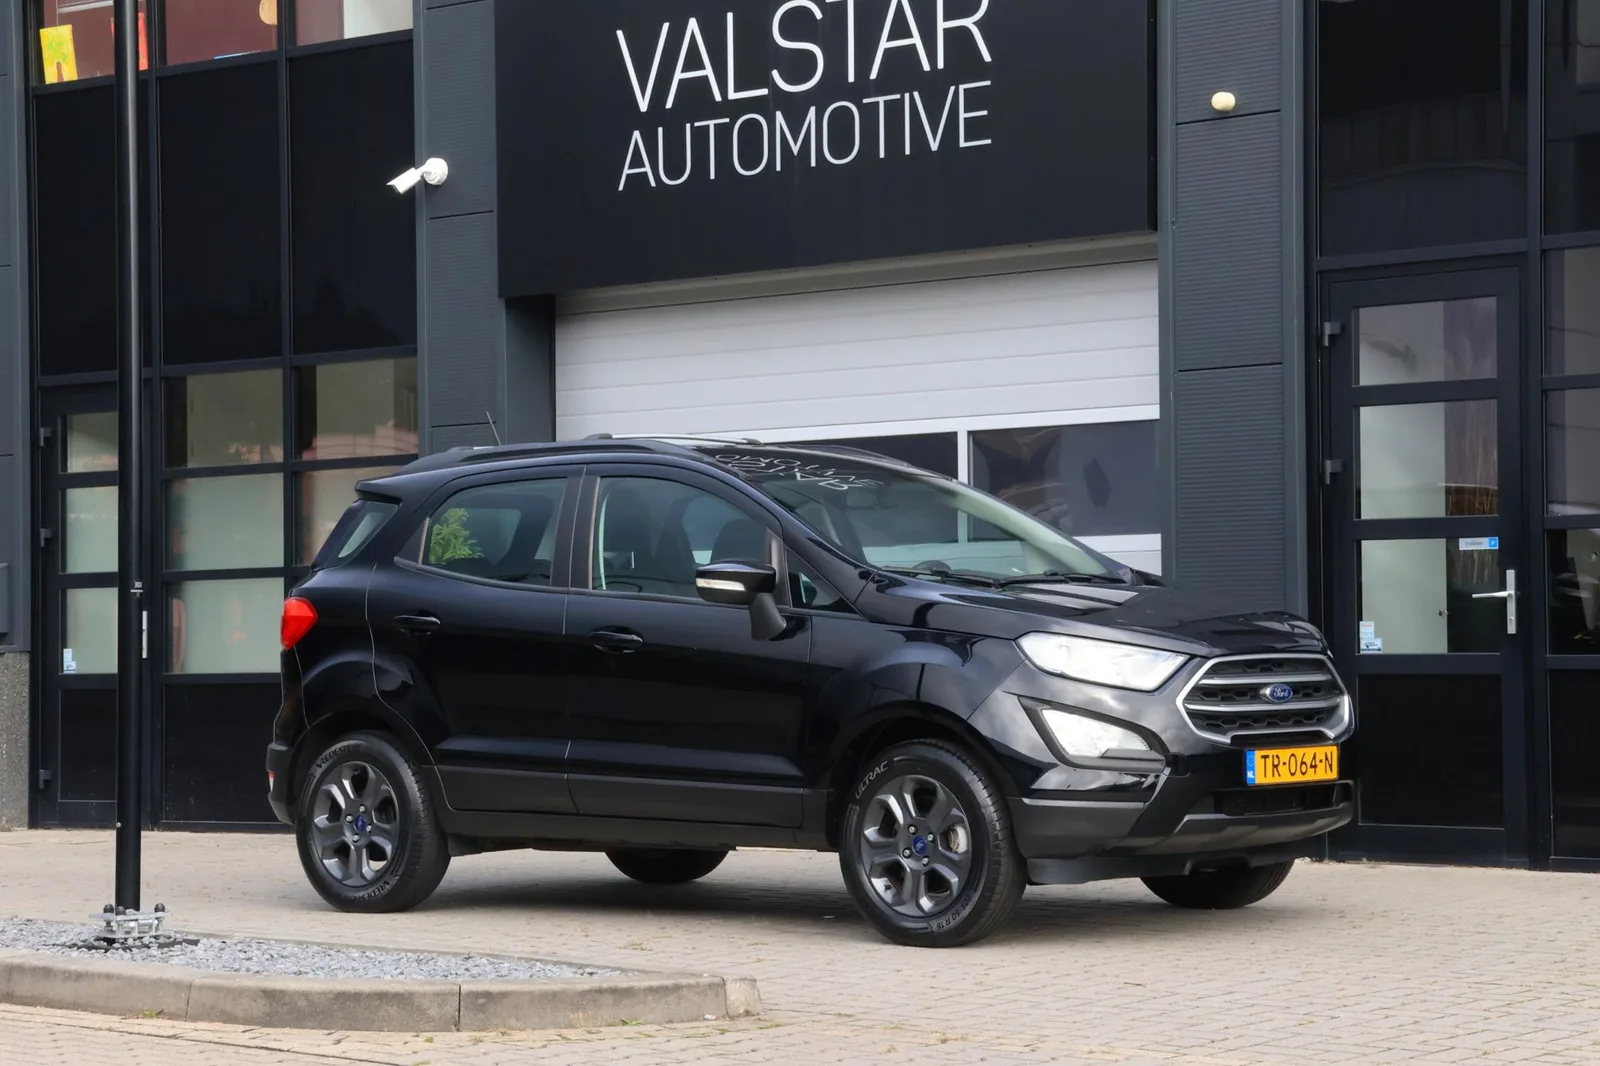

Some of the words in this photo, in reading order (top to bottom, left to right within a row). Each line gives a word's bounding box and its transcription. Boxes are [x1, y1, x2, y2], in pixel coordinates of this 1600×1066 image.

[616, 0, 992, 113] VALSTAR
[618, 80, 992, 191] AUTOMOTIVE
[1272, 686, 1291, 699] Ford
[854, 760, 889, 800] ULTRAC
[1247, 771, 1255, 779] NL
[1260, 751, 1333, 778] TR-064-N
